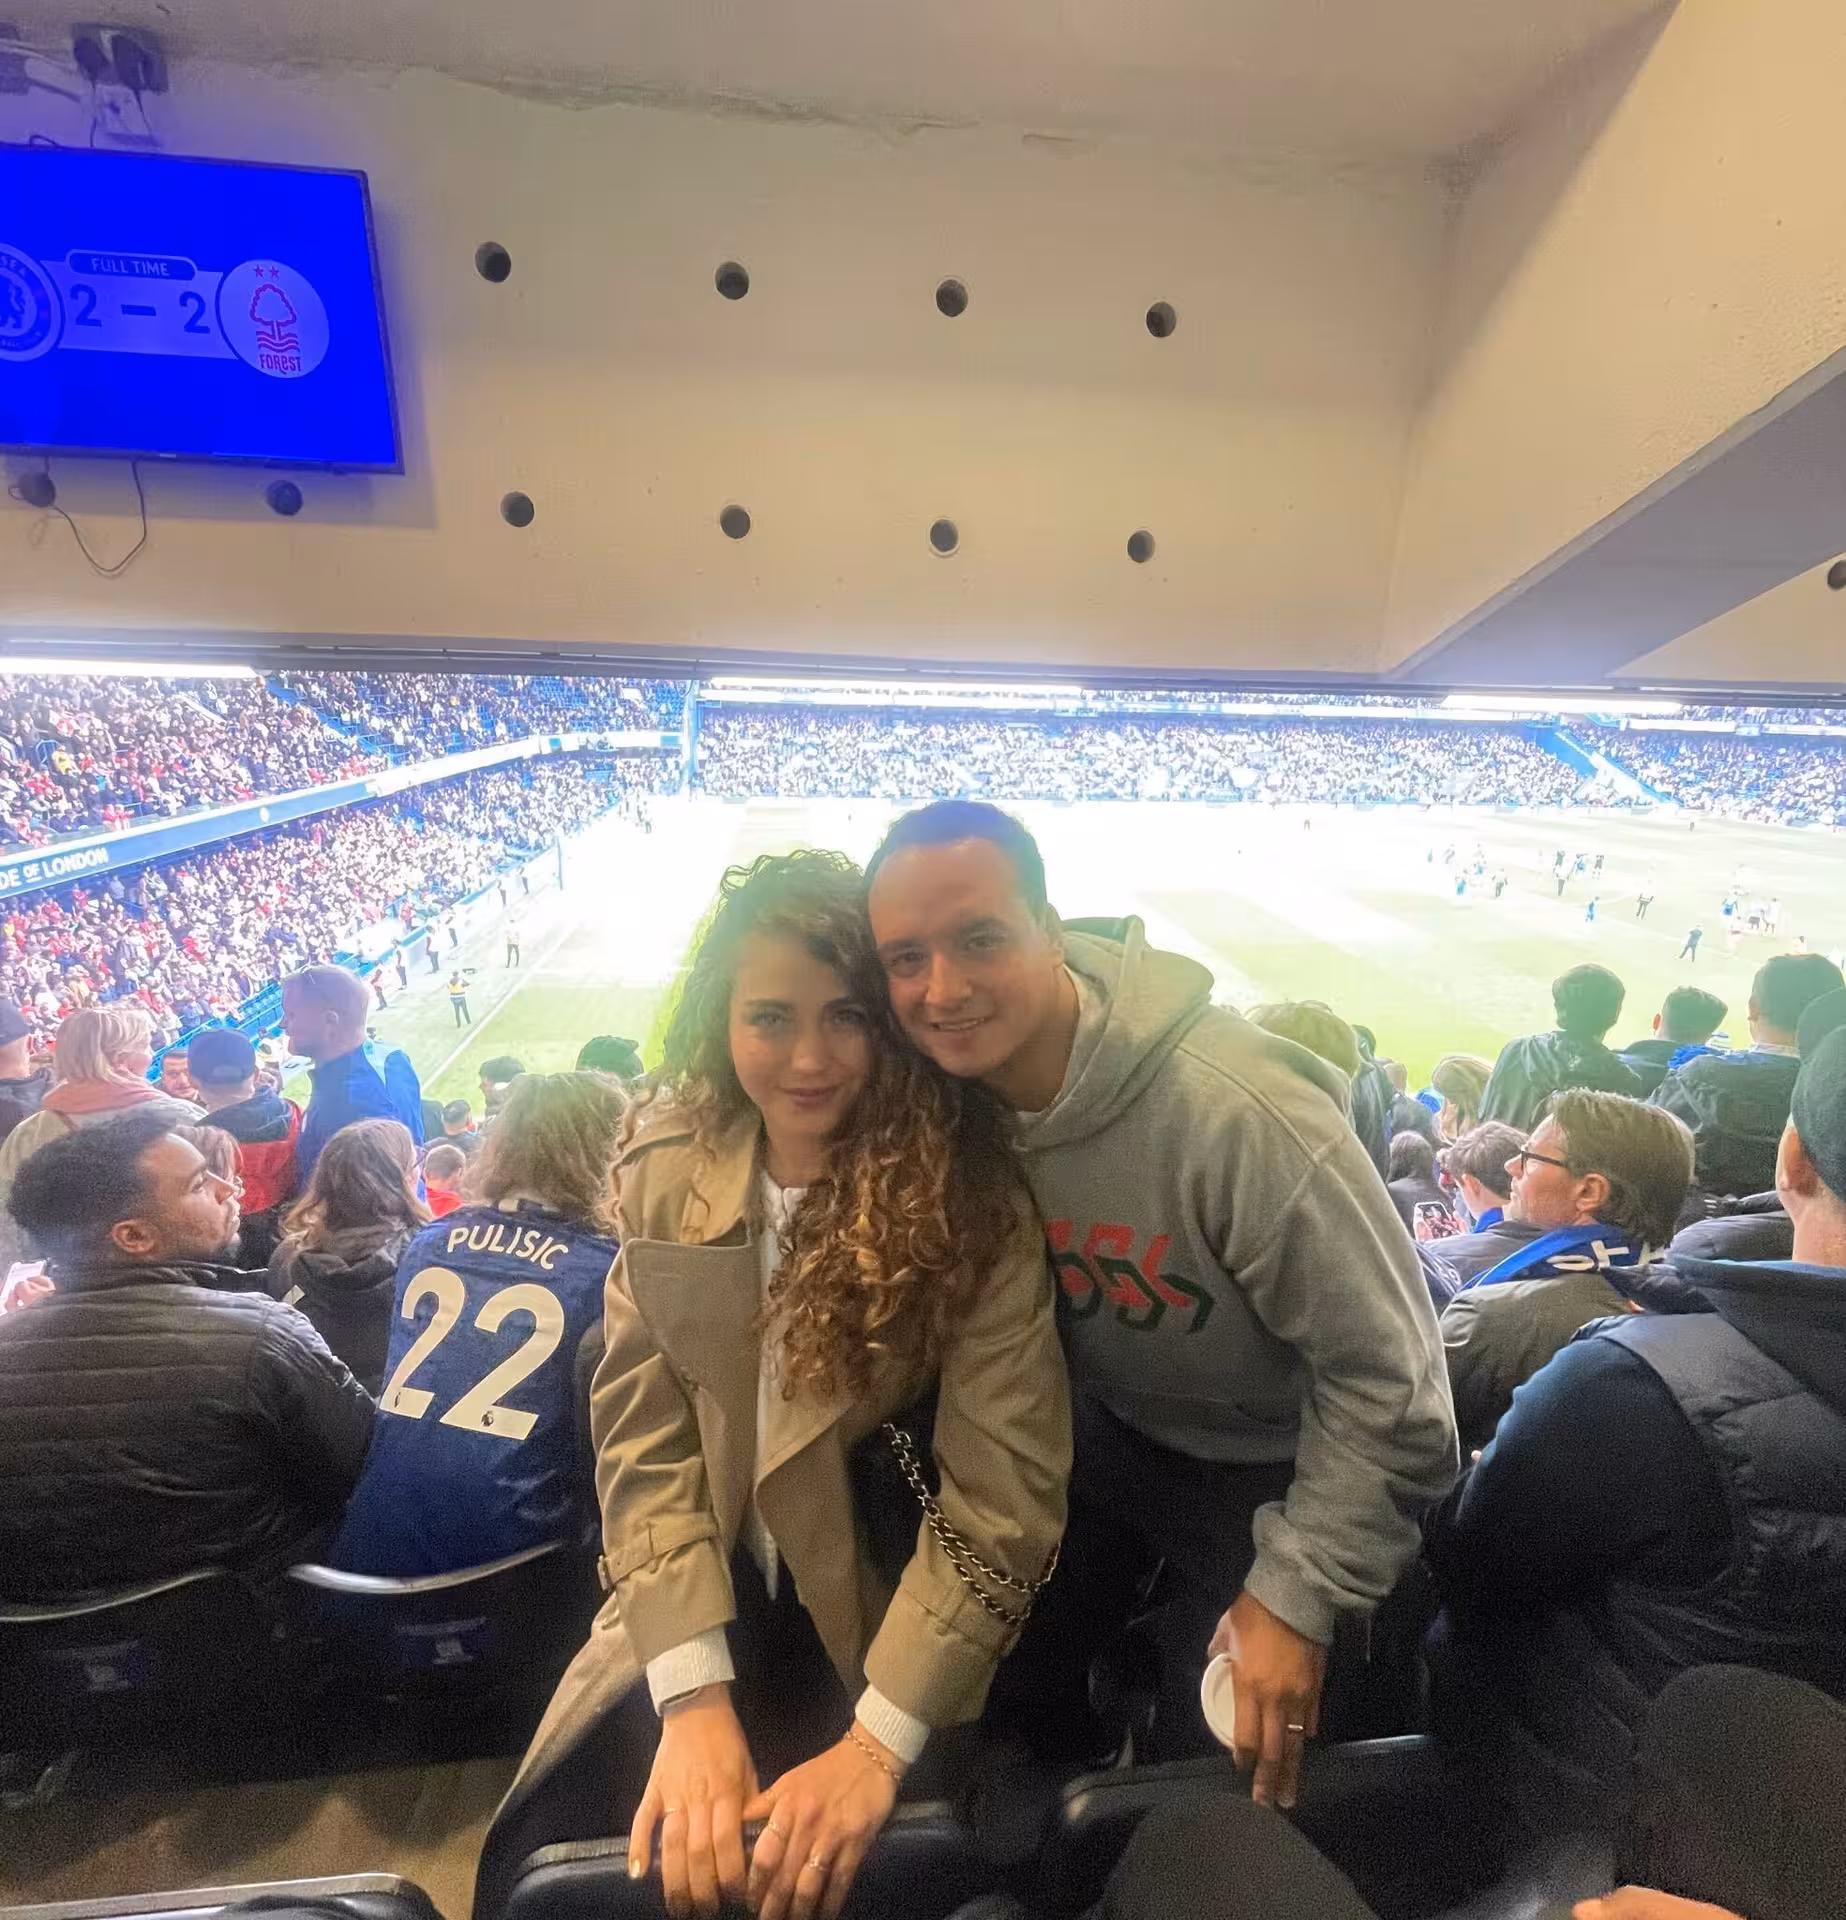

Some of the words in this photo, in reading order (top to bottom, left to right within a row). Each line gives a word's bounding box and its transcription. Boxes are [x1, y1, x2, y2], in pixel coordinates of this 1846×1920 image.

[91, 257, 129, 274] FULL
[130, 259, 170, 277] TIME
[69, 283, 103, 328] 2
[178, 290, 212, 335] 2
[23, 863, 42, 884] OF
[41, 847, 109, 879] LONDON
[447, 1223, 570, 1271] PULISIC
[379, 1266, 566, 1441] 22
